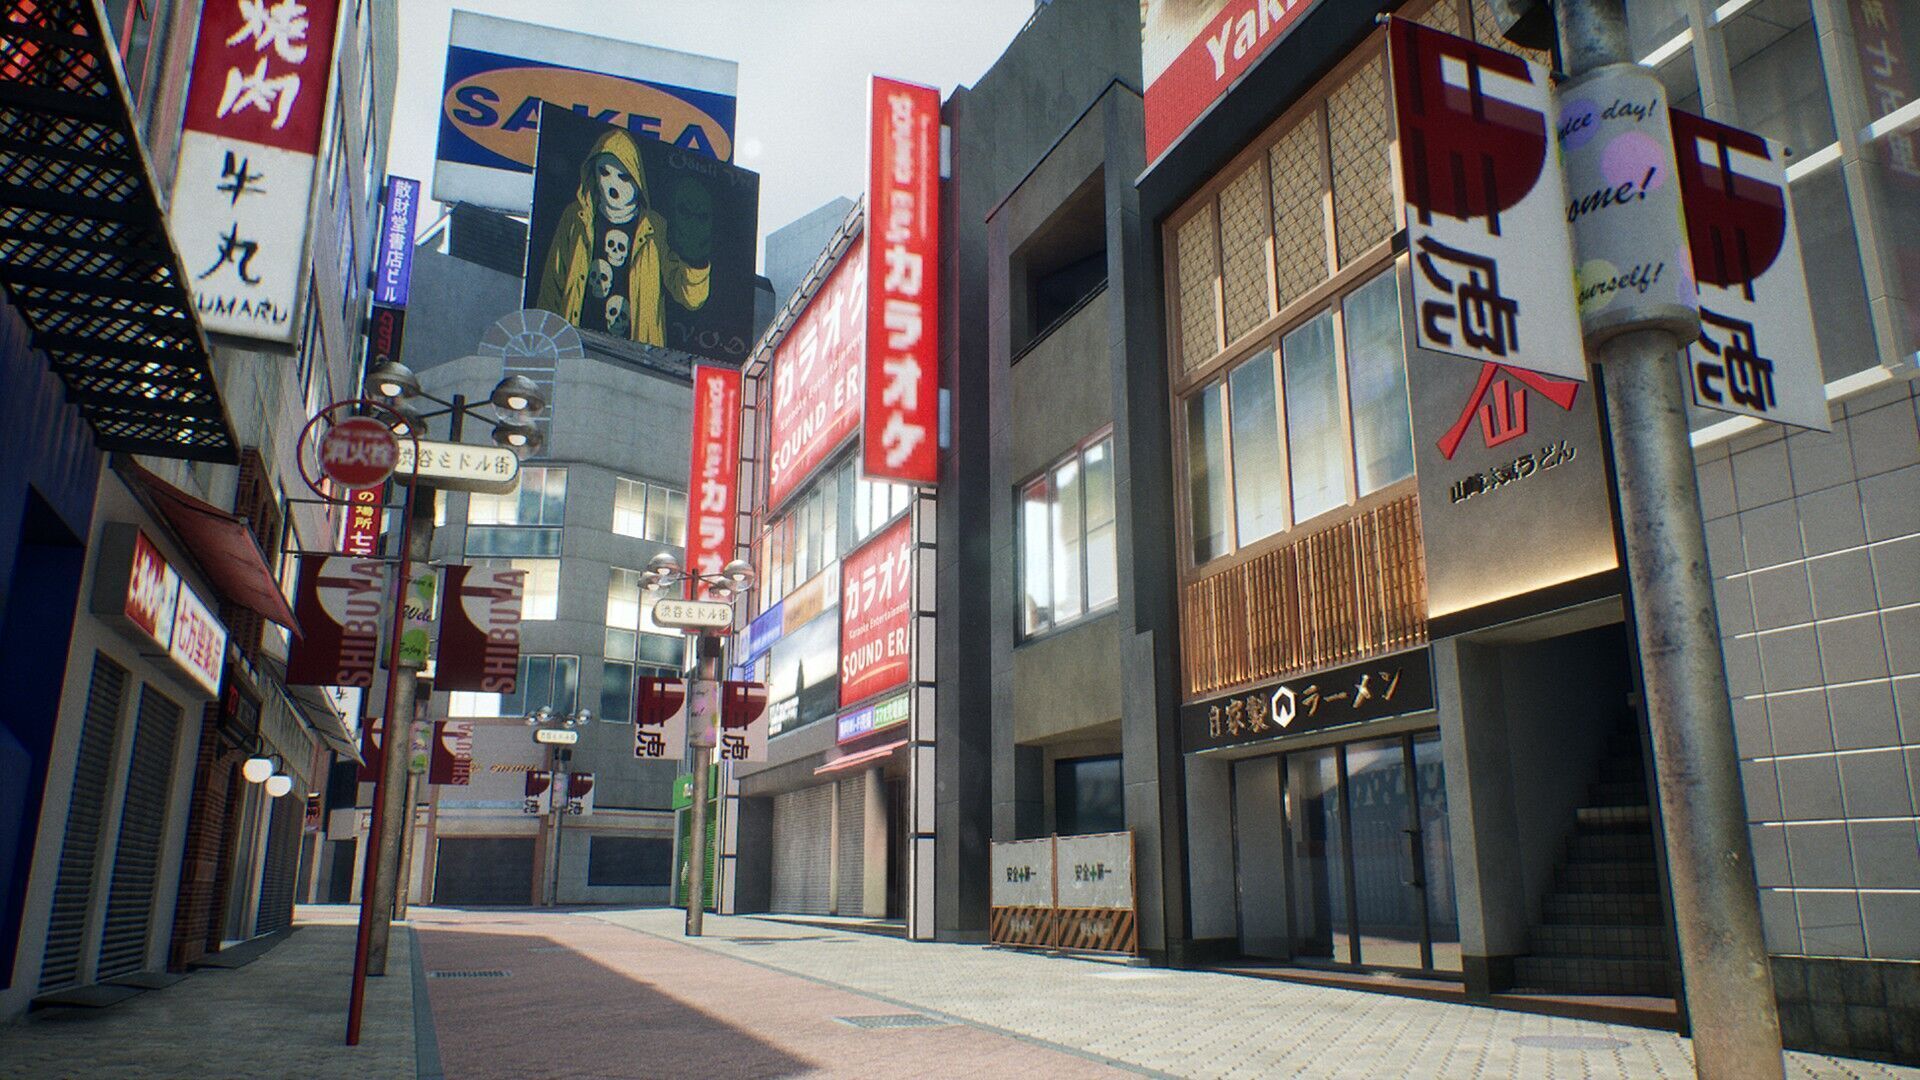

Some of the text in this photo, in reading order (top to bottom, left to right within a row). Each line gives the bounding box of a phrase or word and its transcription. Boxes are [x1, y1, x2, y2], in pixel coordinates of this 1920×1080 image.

[216, 0, 309, 130] 焼肉
[1206, 0, 1297, 81] Yak
[1601, 98, 1656, 122] day!
[198, 150, 266, 284] 牛丸
[882, 246, 926, 468] カラオケ
[400, 447, 509, 475] 渋谷ミドル街
[771, 401, 826, 485] SOUND
[336, 560, 387, 687] SHIBUYA
[845, 541, 910, 624] カラオケ
[481, 569, 527, 693] SHIBUYA
[842, 638, 883, 685] SOUND
[1209, 667, 1402, 738] 自家製 ラーメン
[451, 720, 474, 785] SHIBUYA
